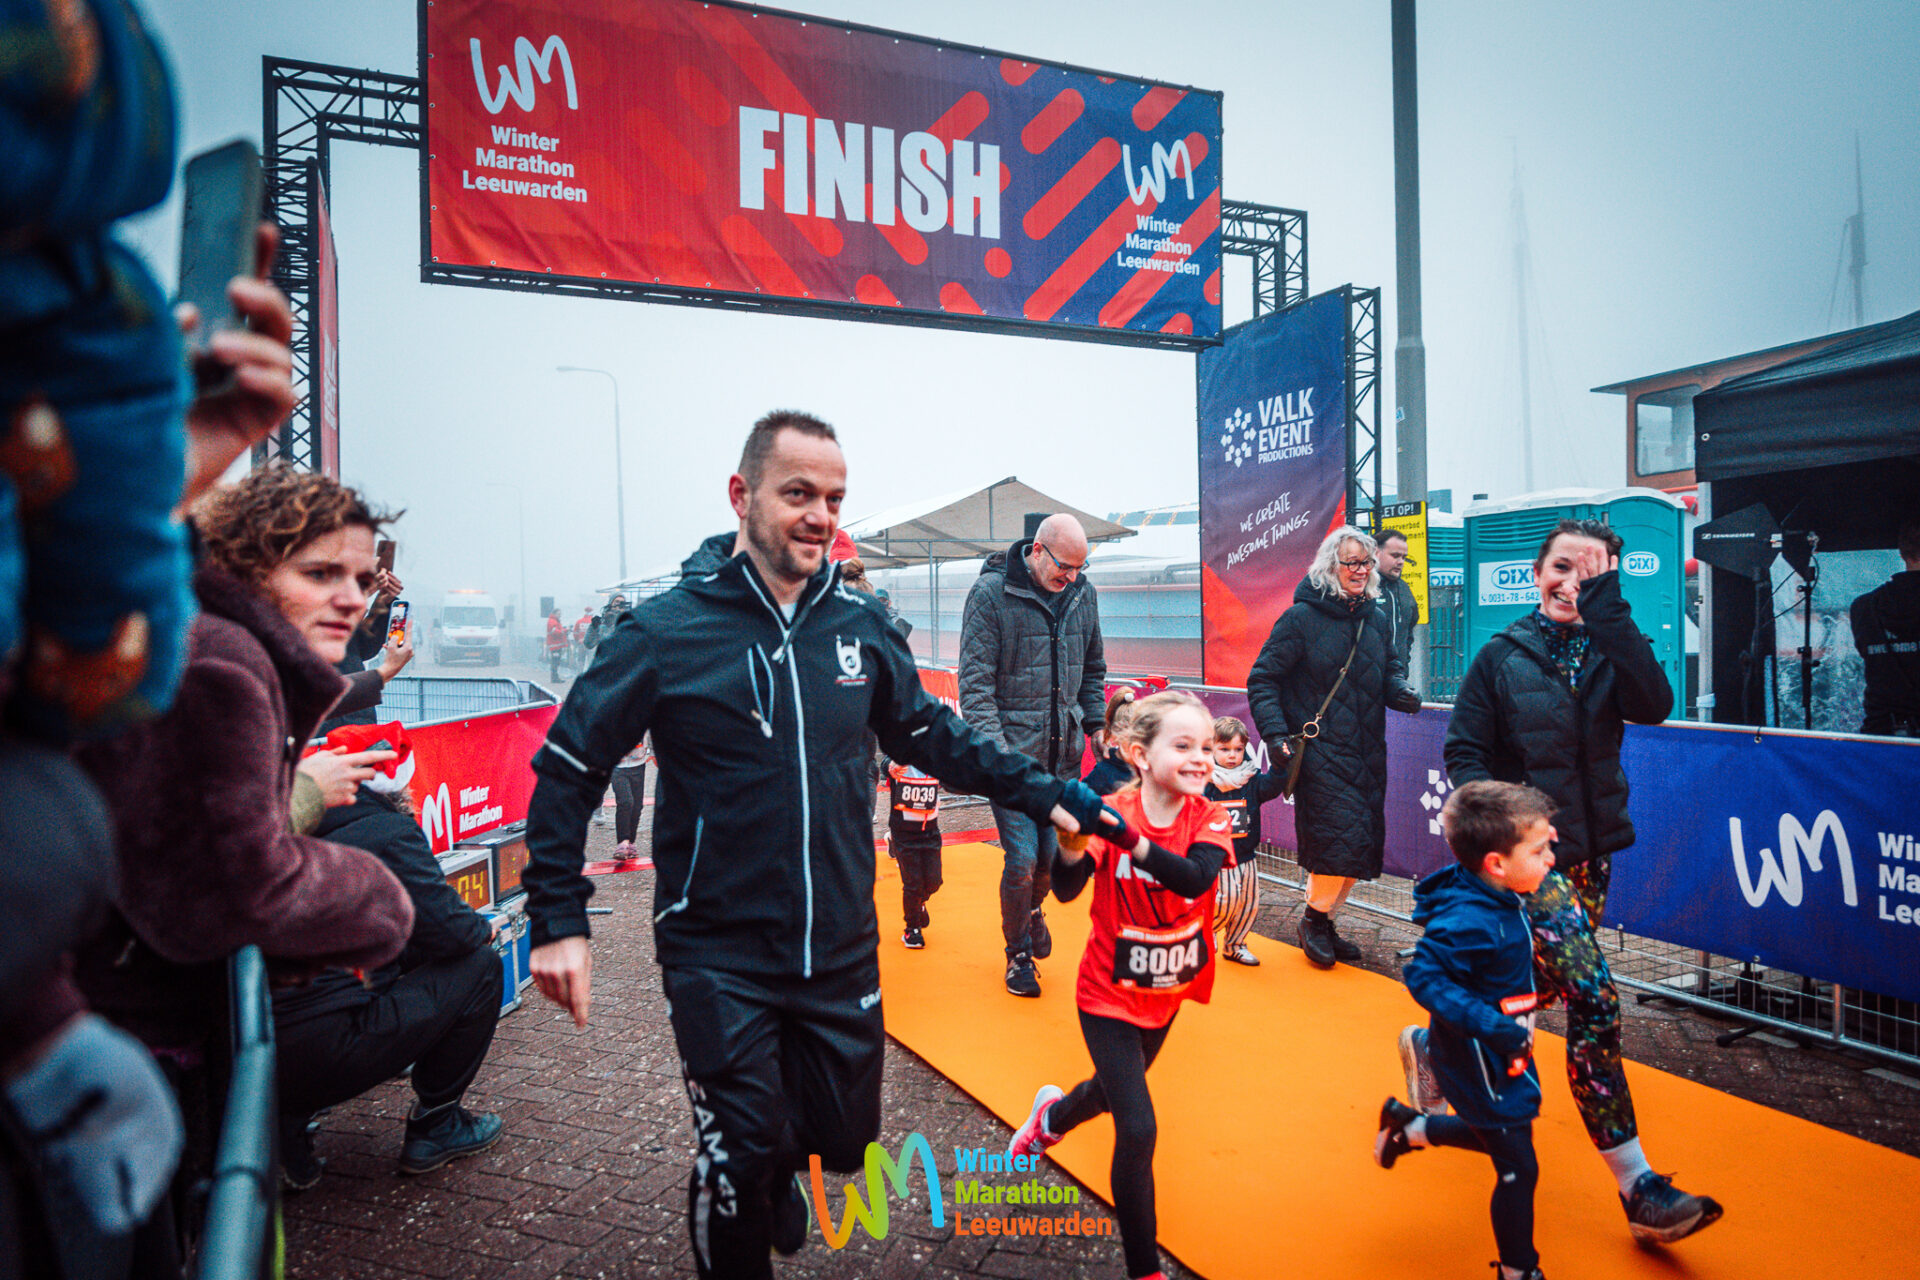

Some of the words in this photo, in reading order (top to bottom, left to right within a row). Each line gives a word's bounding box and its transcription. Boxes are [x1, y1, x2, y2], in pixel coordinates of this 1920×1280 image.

[490, 124, 560, 153] Winter
[475, 148, 575, 178] Marathon
[739, 105, 1001, 240] FINISH
[462, 170, 588, 203] Leeuwarden
[1136, 214, 1182, 236] Winter
[1125, 231, 1192, 257] Marathon
[1117, 251, 1201, 276] Leeuwarden
[1258, 387, 1315, 428] VALK
[1258, 418, 1315, 453] EVENT
[1258, 443, 1315, 465] PRODUCTIONS
[1240, 512, 1254, 534] WE
[1255, 491, 1292, 526] CREATE
[1226, 534, 1269, 571] AWESOME
[1271, 510, 1312, 547] THINGS
[459, 786, 490, 808] Winter
[901, 786, 936, 802] 8039
[459, 805, 503, 834] Marathon
[1129, 938, 1199, 975] 8004
